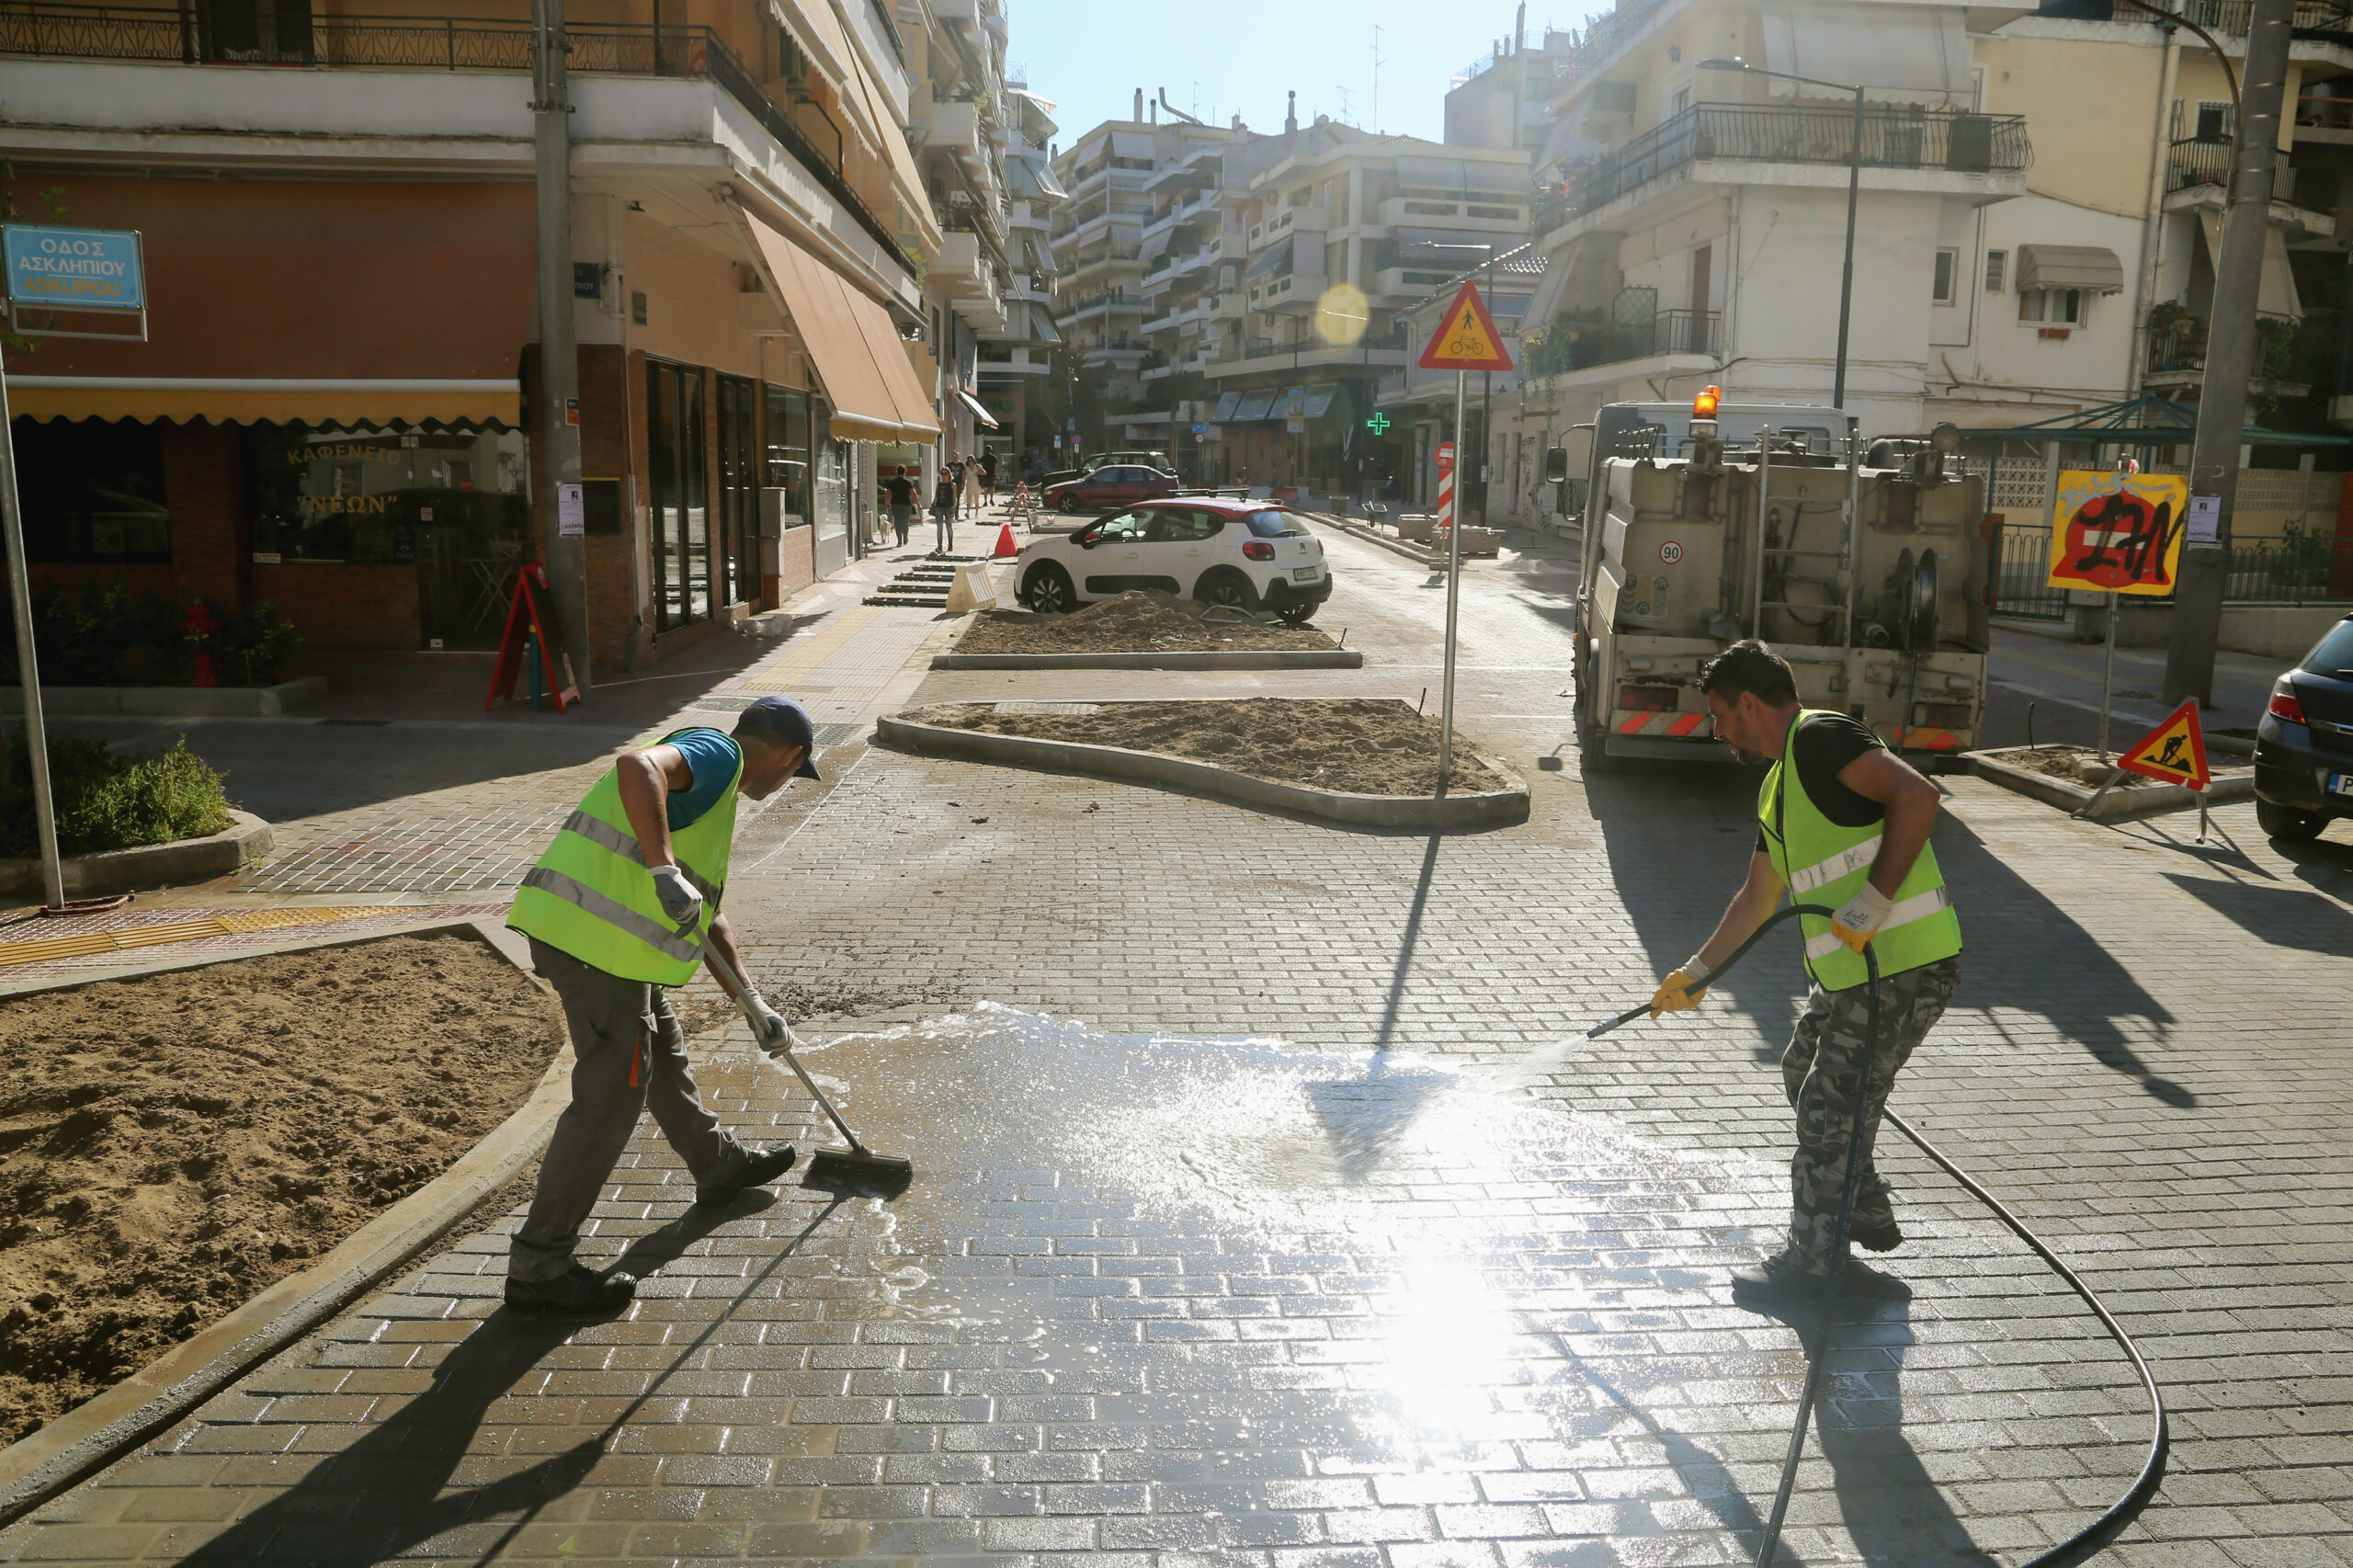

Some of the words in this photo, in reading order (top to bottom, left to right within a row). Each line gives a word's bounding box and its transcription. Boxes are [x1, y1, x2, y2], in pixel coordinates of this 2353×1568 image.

[40, 238, 105, 256] ΟΔΟΣ
[19, 256, 125, 276] ΑΣΚΛΗΠΙΟΥ
[24, 277, 120, 297] ASKLIPIOU
[574, 282, 595, 290] ΠΙΟΥ
[287, 445, 401, 465] ΚΑΦΕΝΕΙΟ
[1664, 547, 1679, 559] 90
